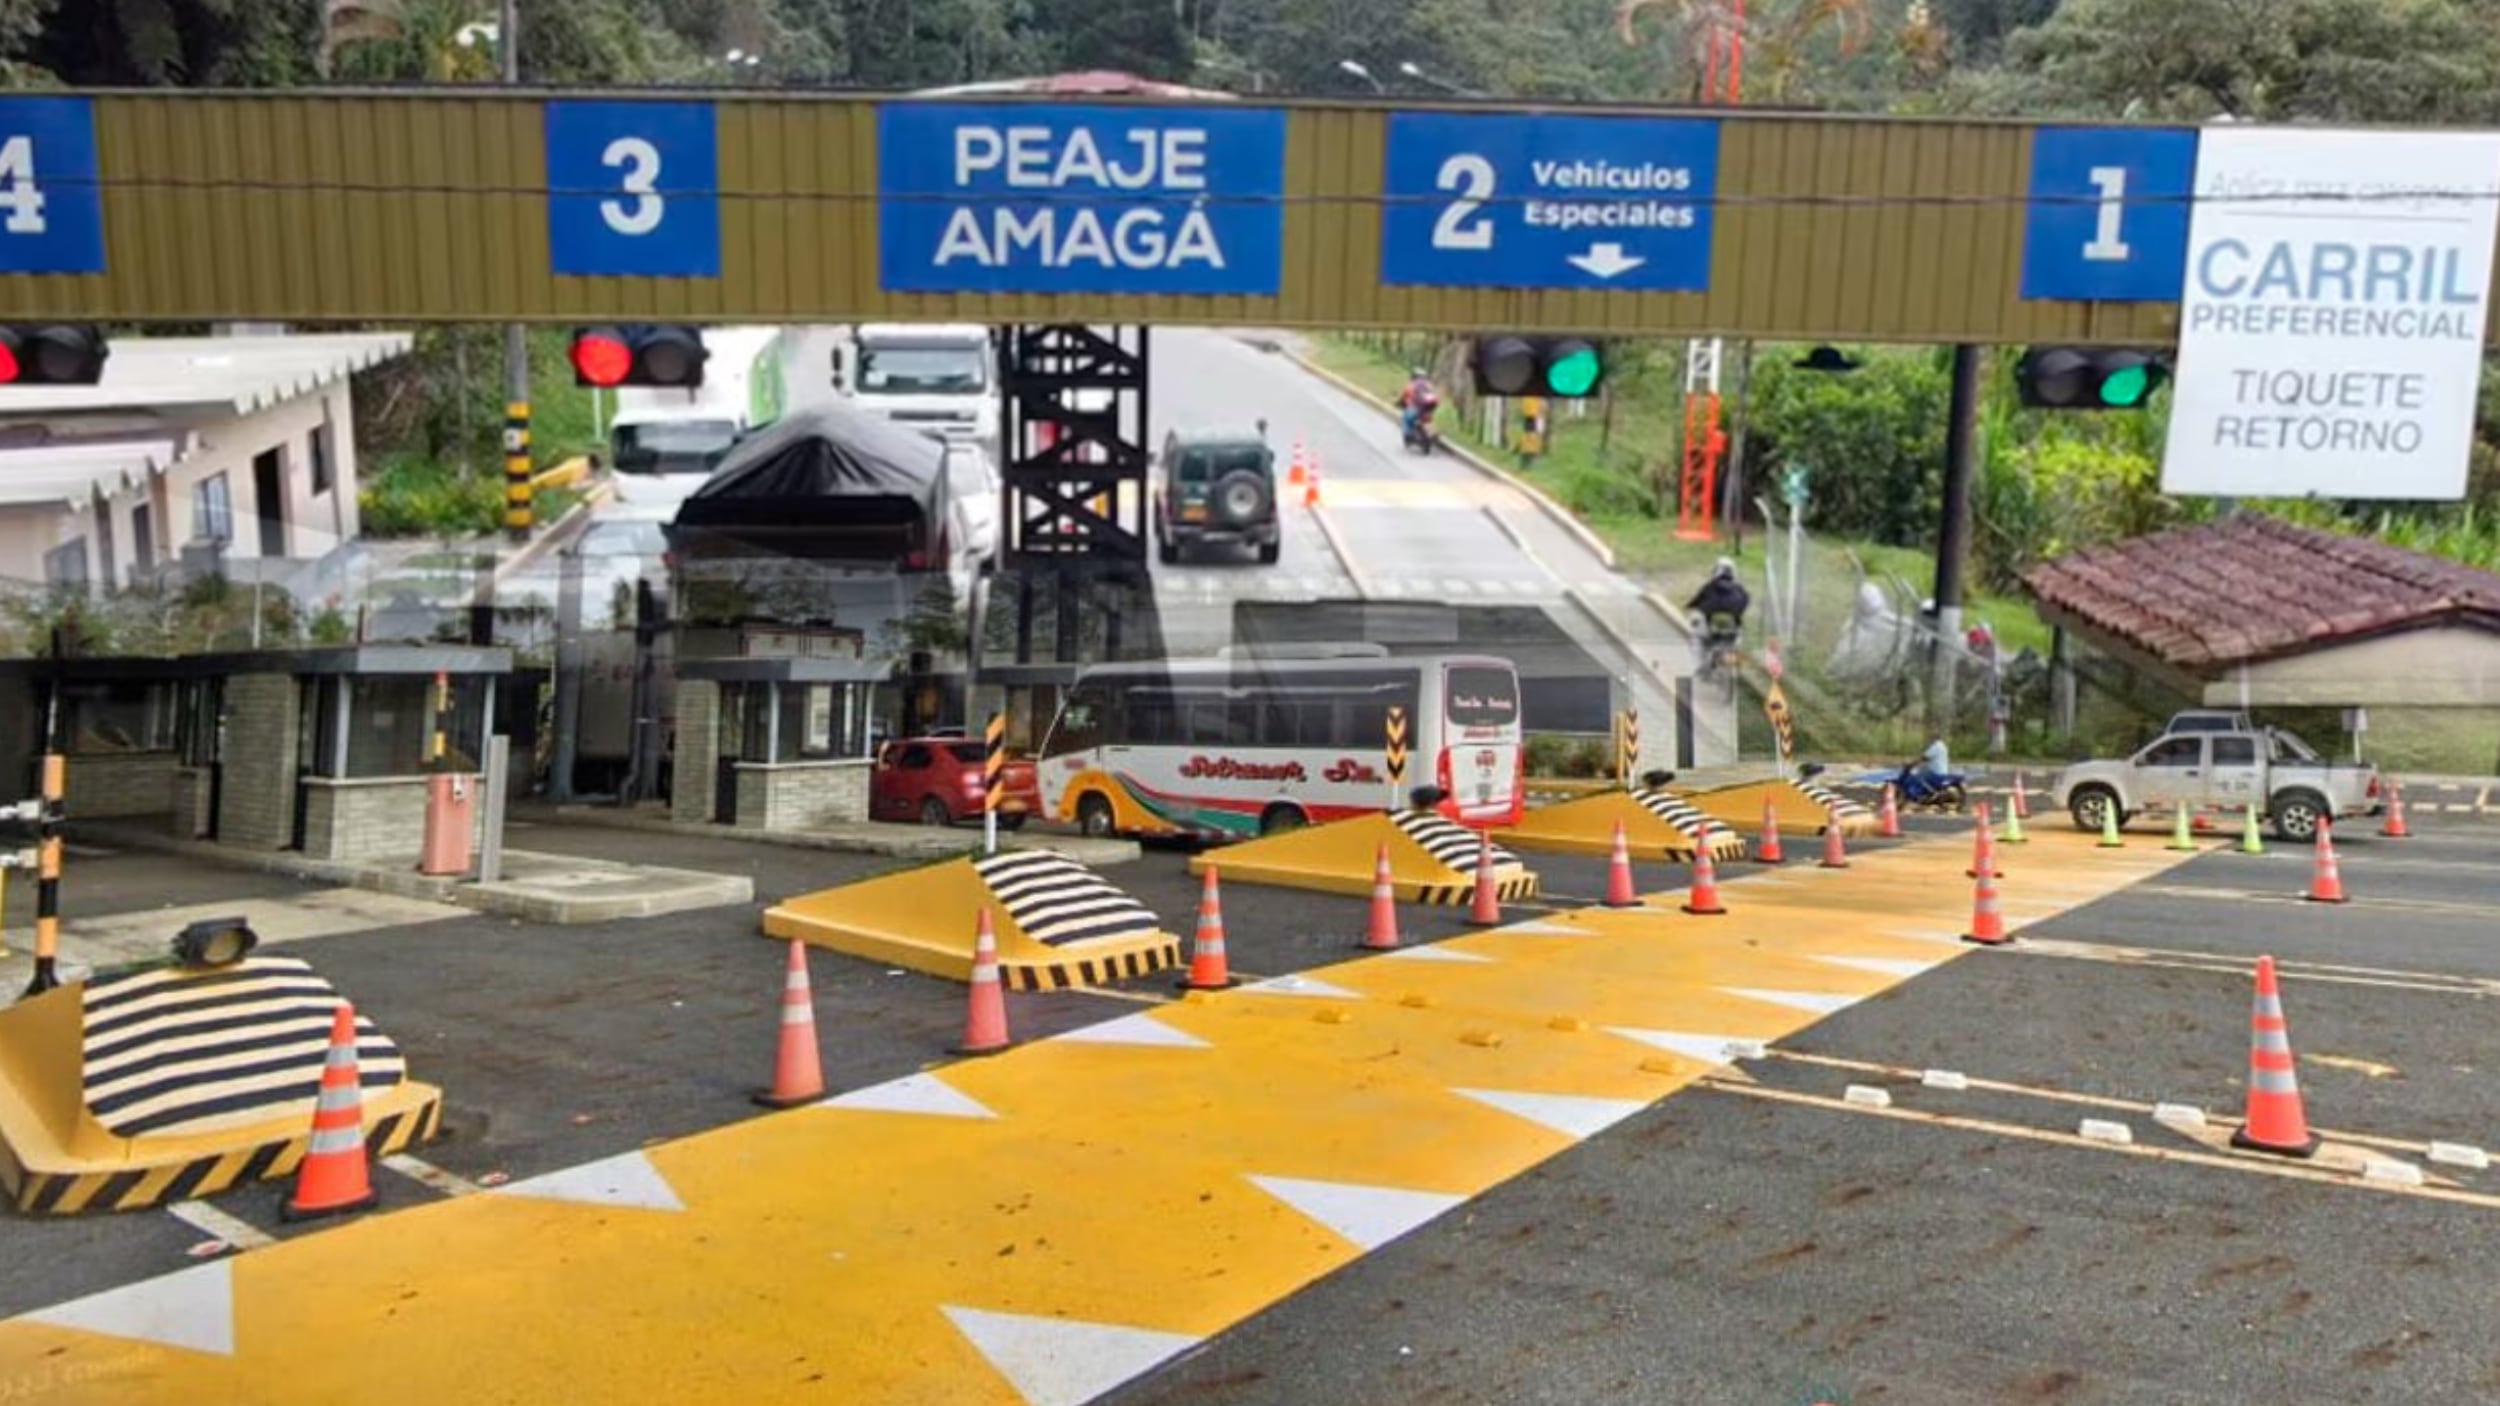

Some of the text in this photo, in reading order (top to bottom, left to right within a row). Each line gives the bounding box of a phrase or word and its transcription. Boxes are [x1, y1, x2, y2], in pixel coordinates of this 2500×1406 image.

[0, 136, 46, 233] 4
[600, 137, 664, 235] 3
[954, 125, 1206, 189] PEAJE
[1532, 160, 1692, 190] Vehículos
[933, 196, 1225, 269] AMAGÁ
[1432, 153, 1496, 250] 2
[1524, 200, 1694, 229] Especiales
[2083, 166, 2130, 261] 1
[2197, 236, 2481, 304] CARRIL
[2191, 303, 2476, 340] PREFERENCIAL
[2231, 369, 2425, 408] TIQUETE
[2213, 416, 2423, 453] RETORNO
